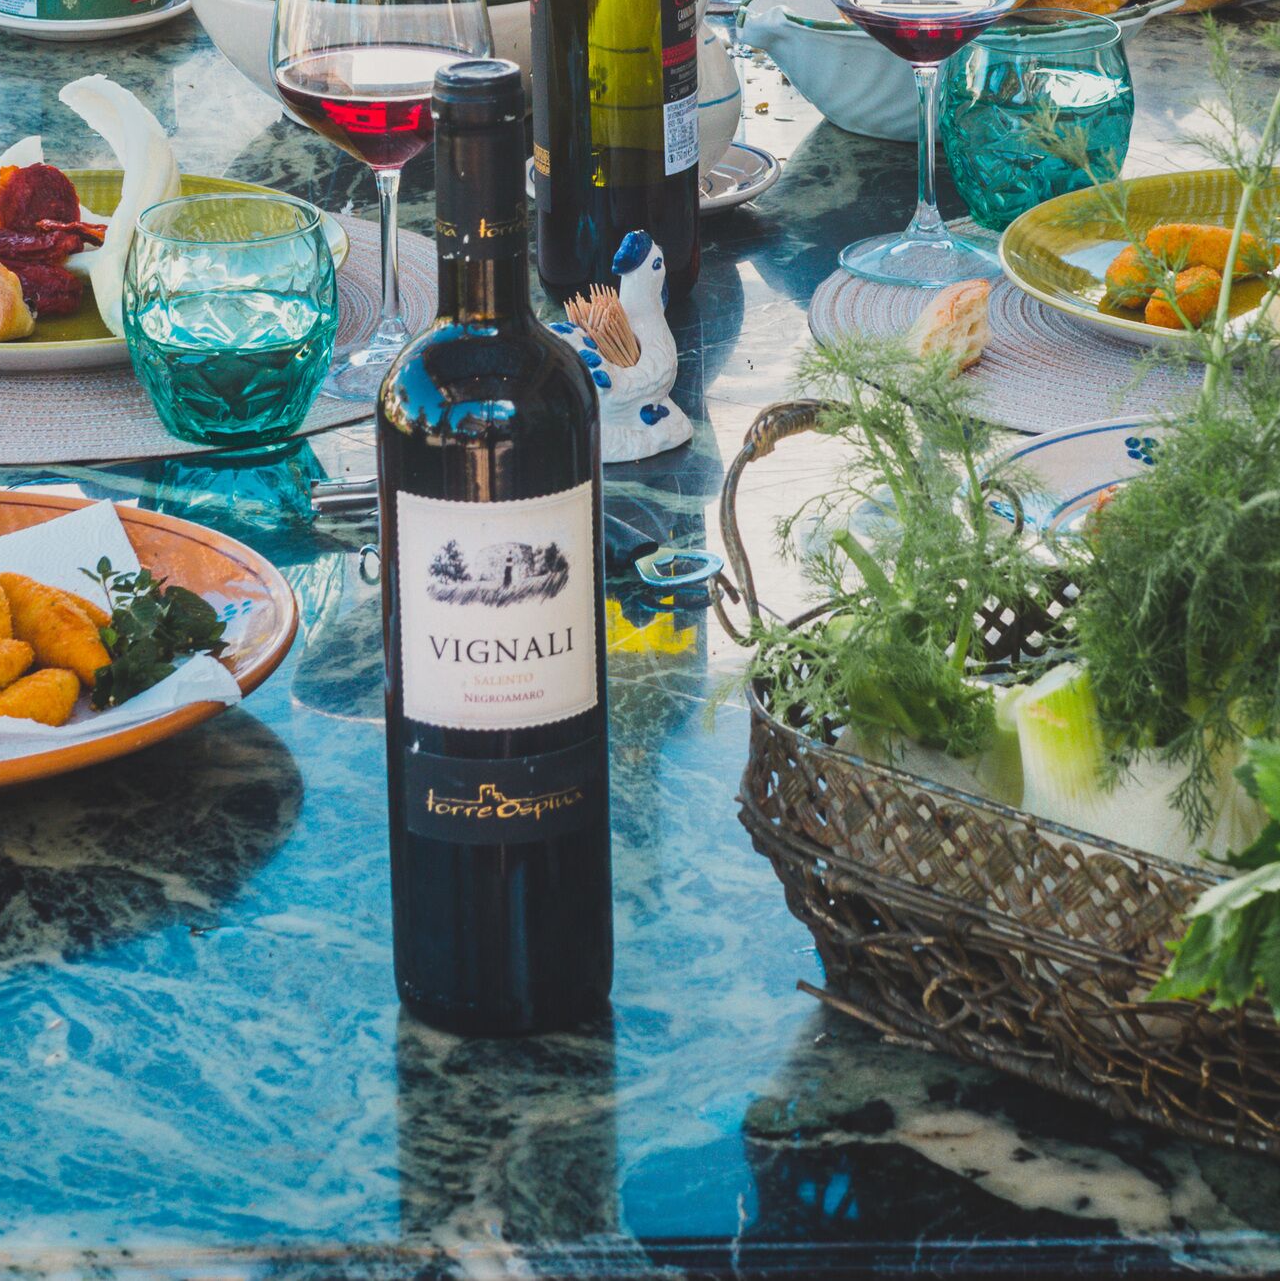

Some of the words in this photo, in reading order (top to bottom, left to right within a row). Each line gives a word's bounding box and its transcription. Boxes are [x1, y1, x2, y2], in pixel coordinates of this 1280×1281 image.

[429, 627, 574, 664] VIGNALI
[473, 672, 535, 687] SALENTO
[464, 689, 546, 703] NEGROAMARO
